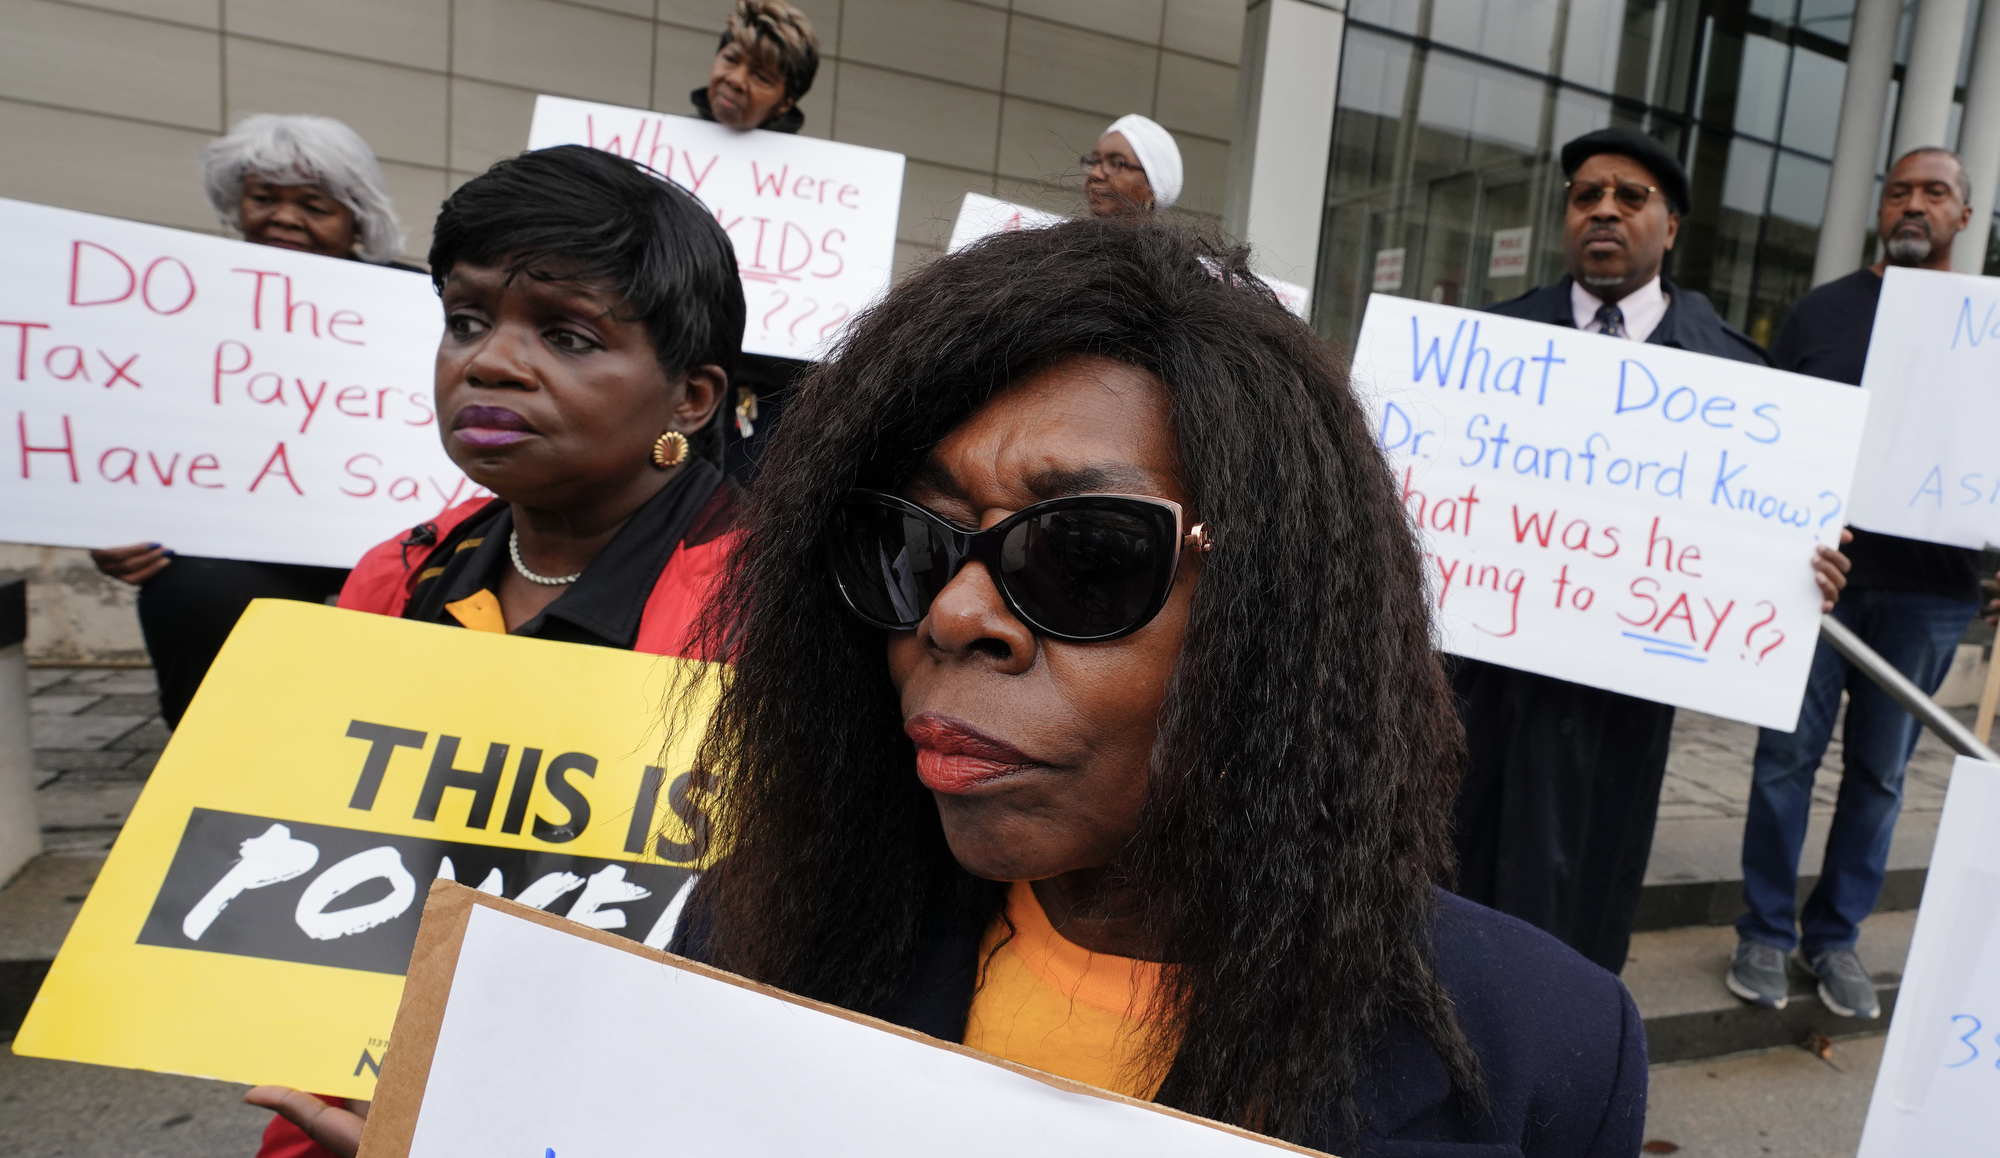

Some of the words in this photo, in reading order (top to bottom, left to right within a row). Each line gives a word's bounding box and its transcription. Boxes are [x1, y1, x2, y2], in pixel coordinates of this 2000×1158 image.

[67, 240, 197, 316] DO
[230, 268, 367, 346] The
[0, 321, 143, 390] Tax
[212, 340, 436, 434] Payers
[1411, 315, 1567, 406] What
[1614, 359, 1782, 444] Does
[17, 410, 226, 489] Have
[248, 442, 305, 496] A
[1459, 414, 1689, 499] Stanford
[1710, 450, 1843, 541] Know?
[1391, 465, 1480, 536] hat
[1646, 516, 1703, 579] he
[1420, 553, 1526, 637] ying
[1553, 565, 1595, 611] to
[344, 719, 600, 843] THIS
[622, 765, 721, 864] IS
